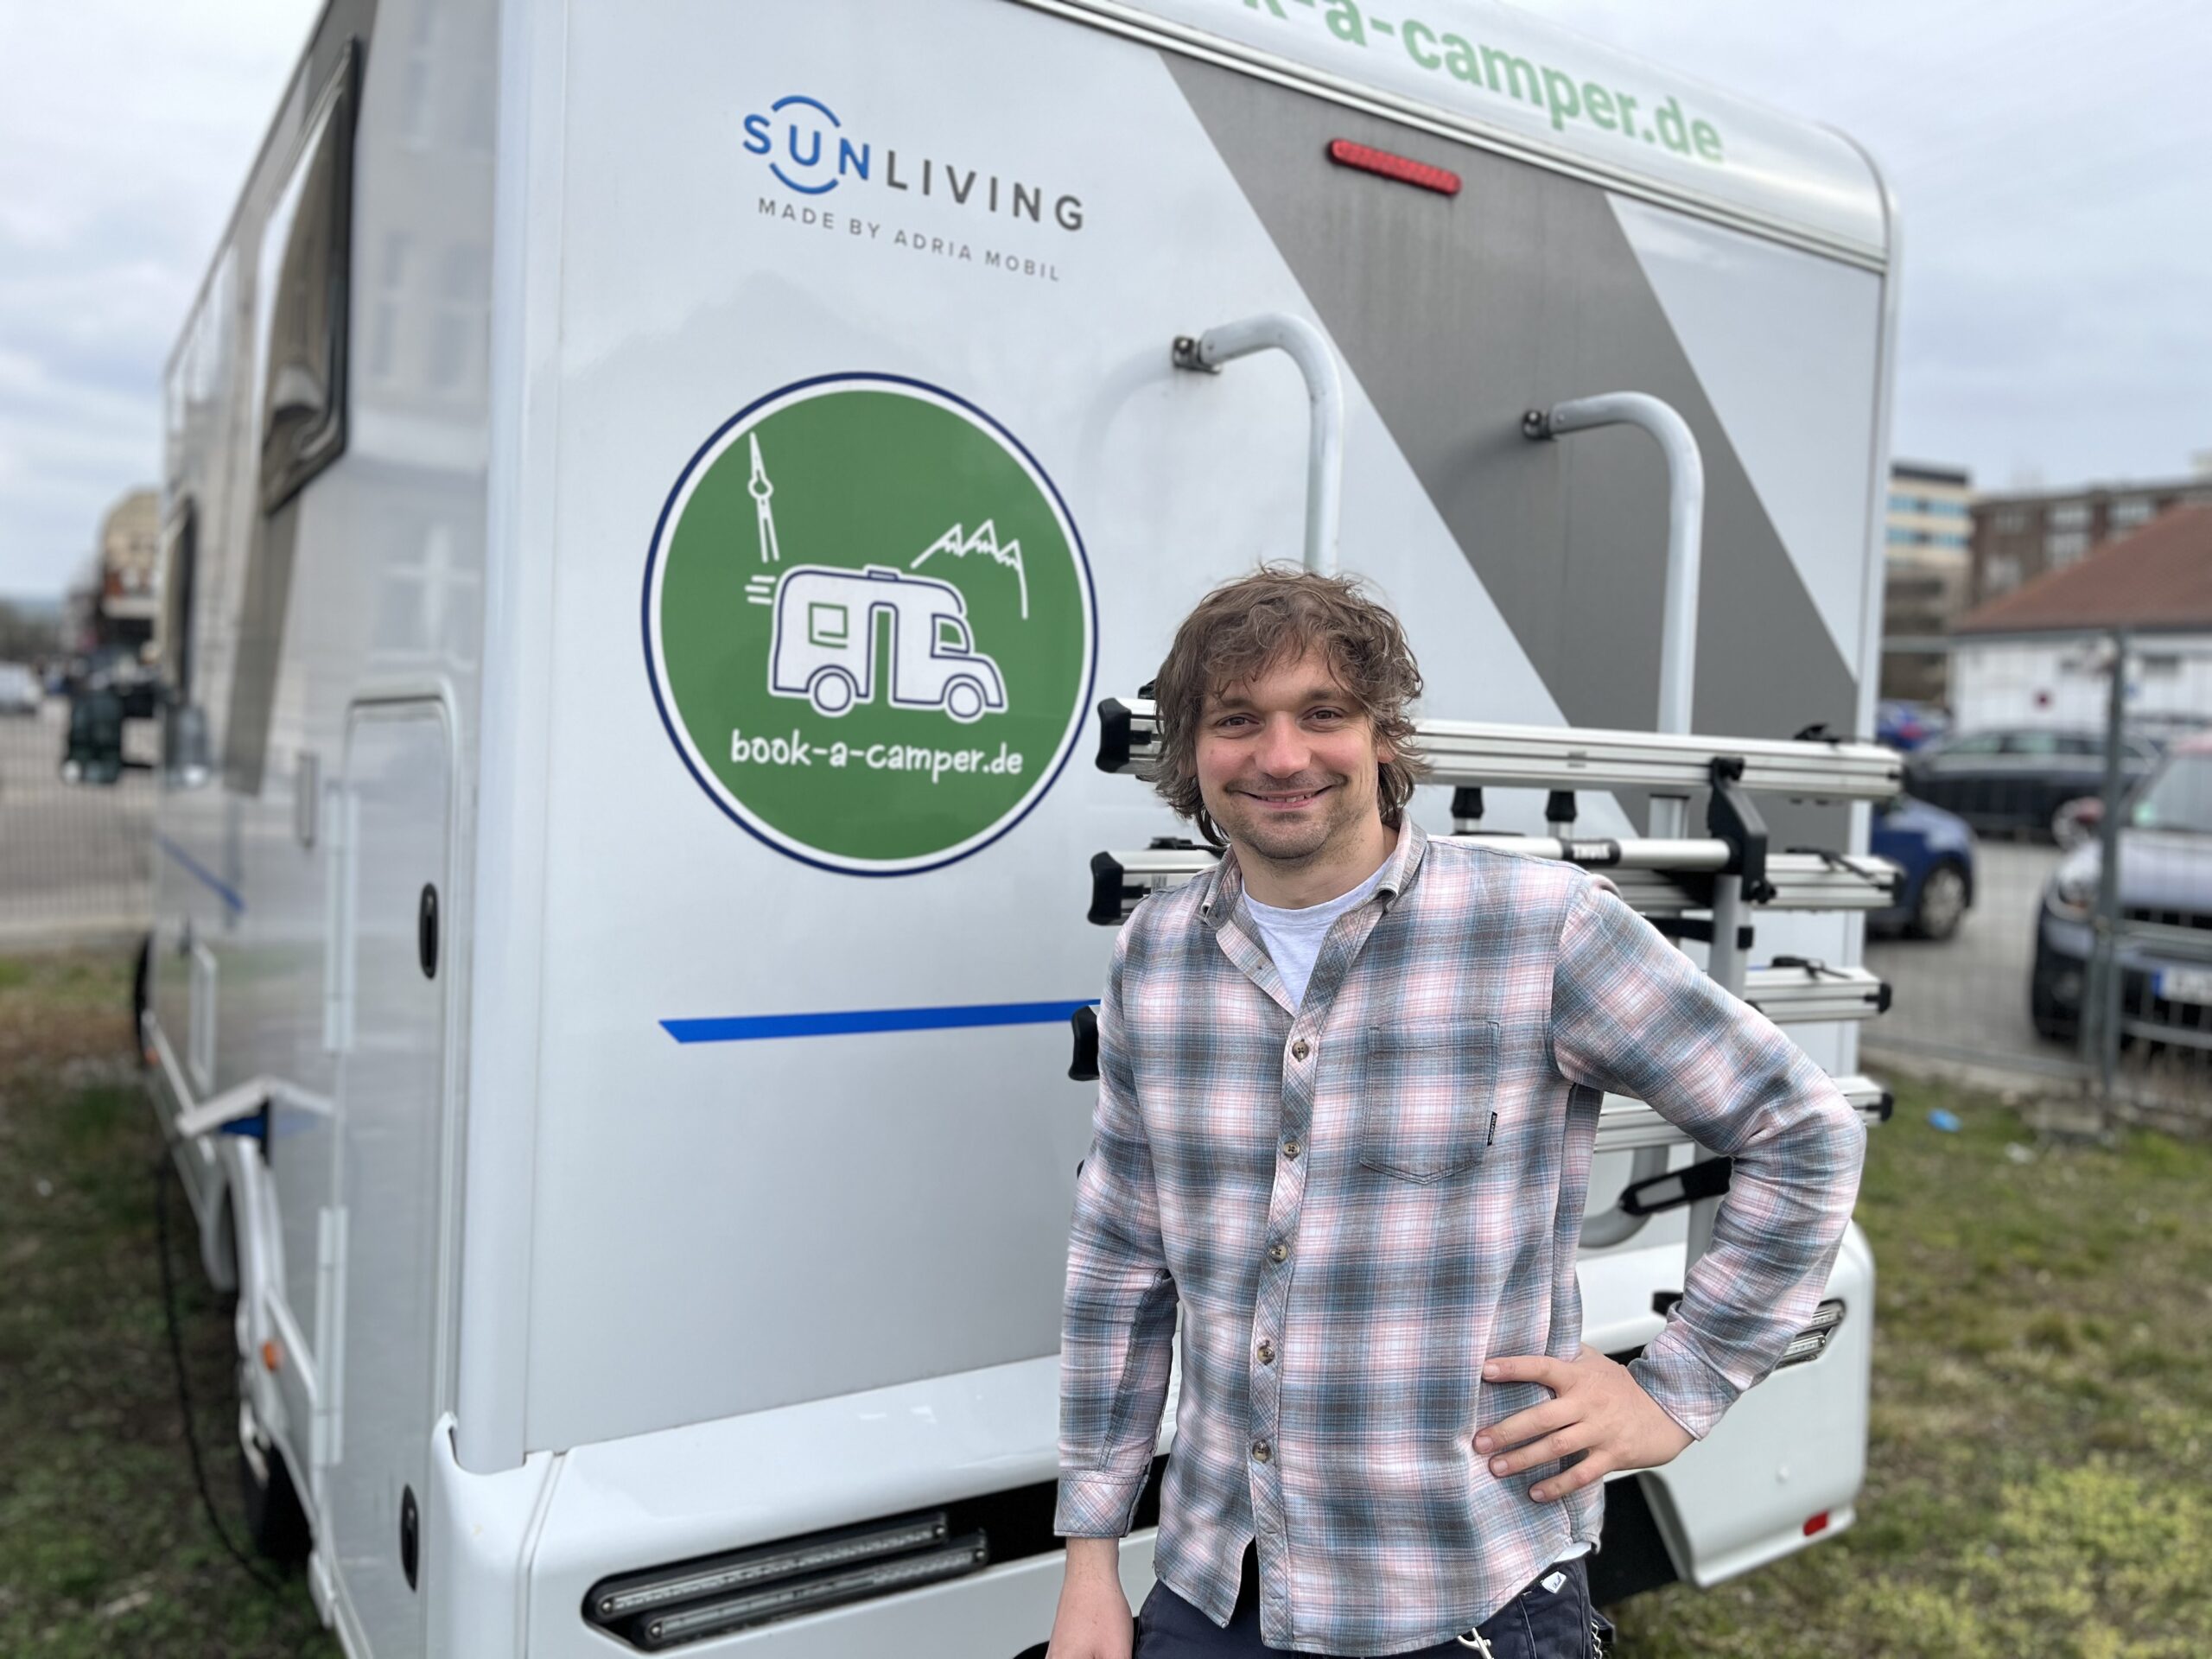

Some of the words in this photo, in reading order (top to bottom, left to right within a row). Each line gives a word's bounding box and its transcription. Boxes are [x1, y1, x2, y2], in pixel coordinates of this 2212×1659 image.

[1243, 0, 1724, 162] a-camper.de
[742, 113, 1084, 232] SUNLIVING
[758, 197, 835, 230] MADE
[849, 218, 881, 238] BY
[893, 229, 973, 261] ADRIA
[984, 250, 1060, 282] MOBIL
[730, 728, 1024, 784] book-a-camper.de
